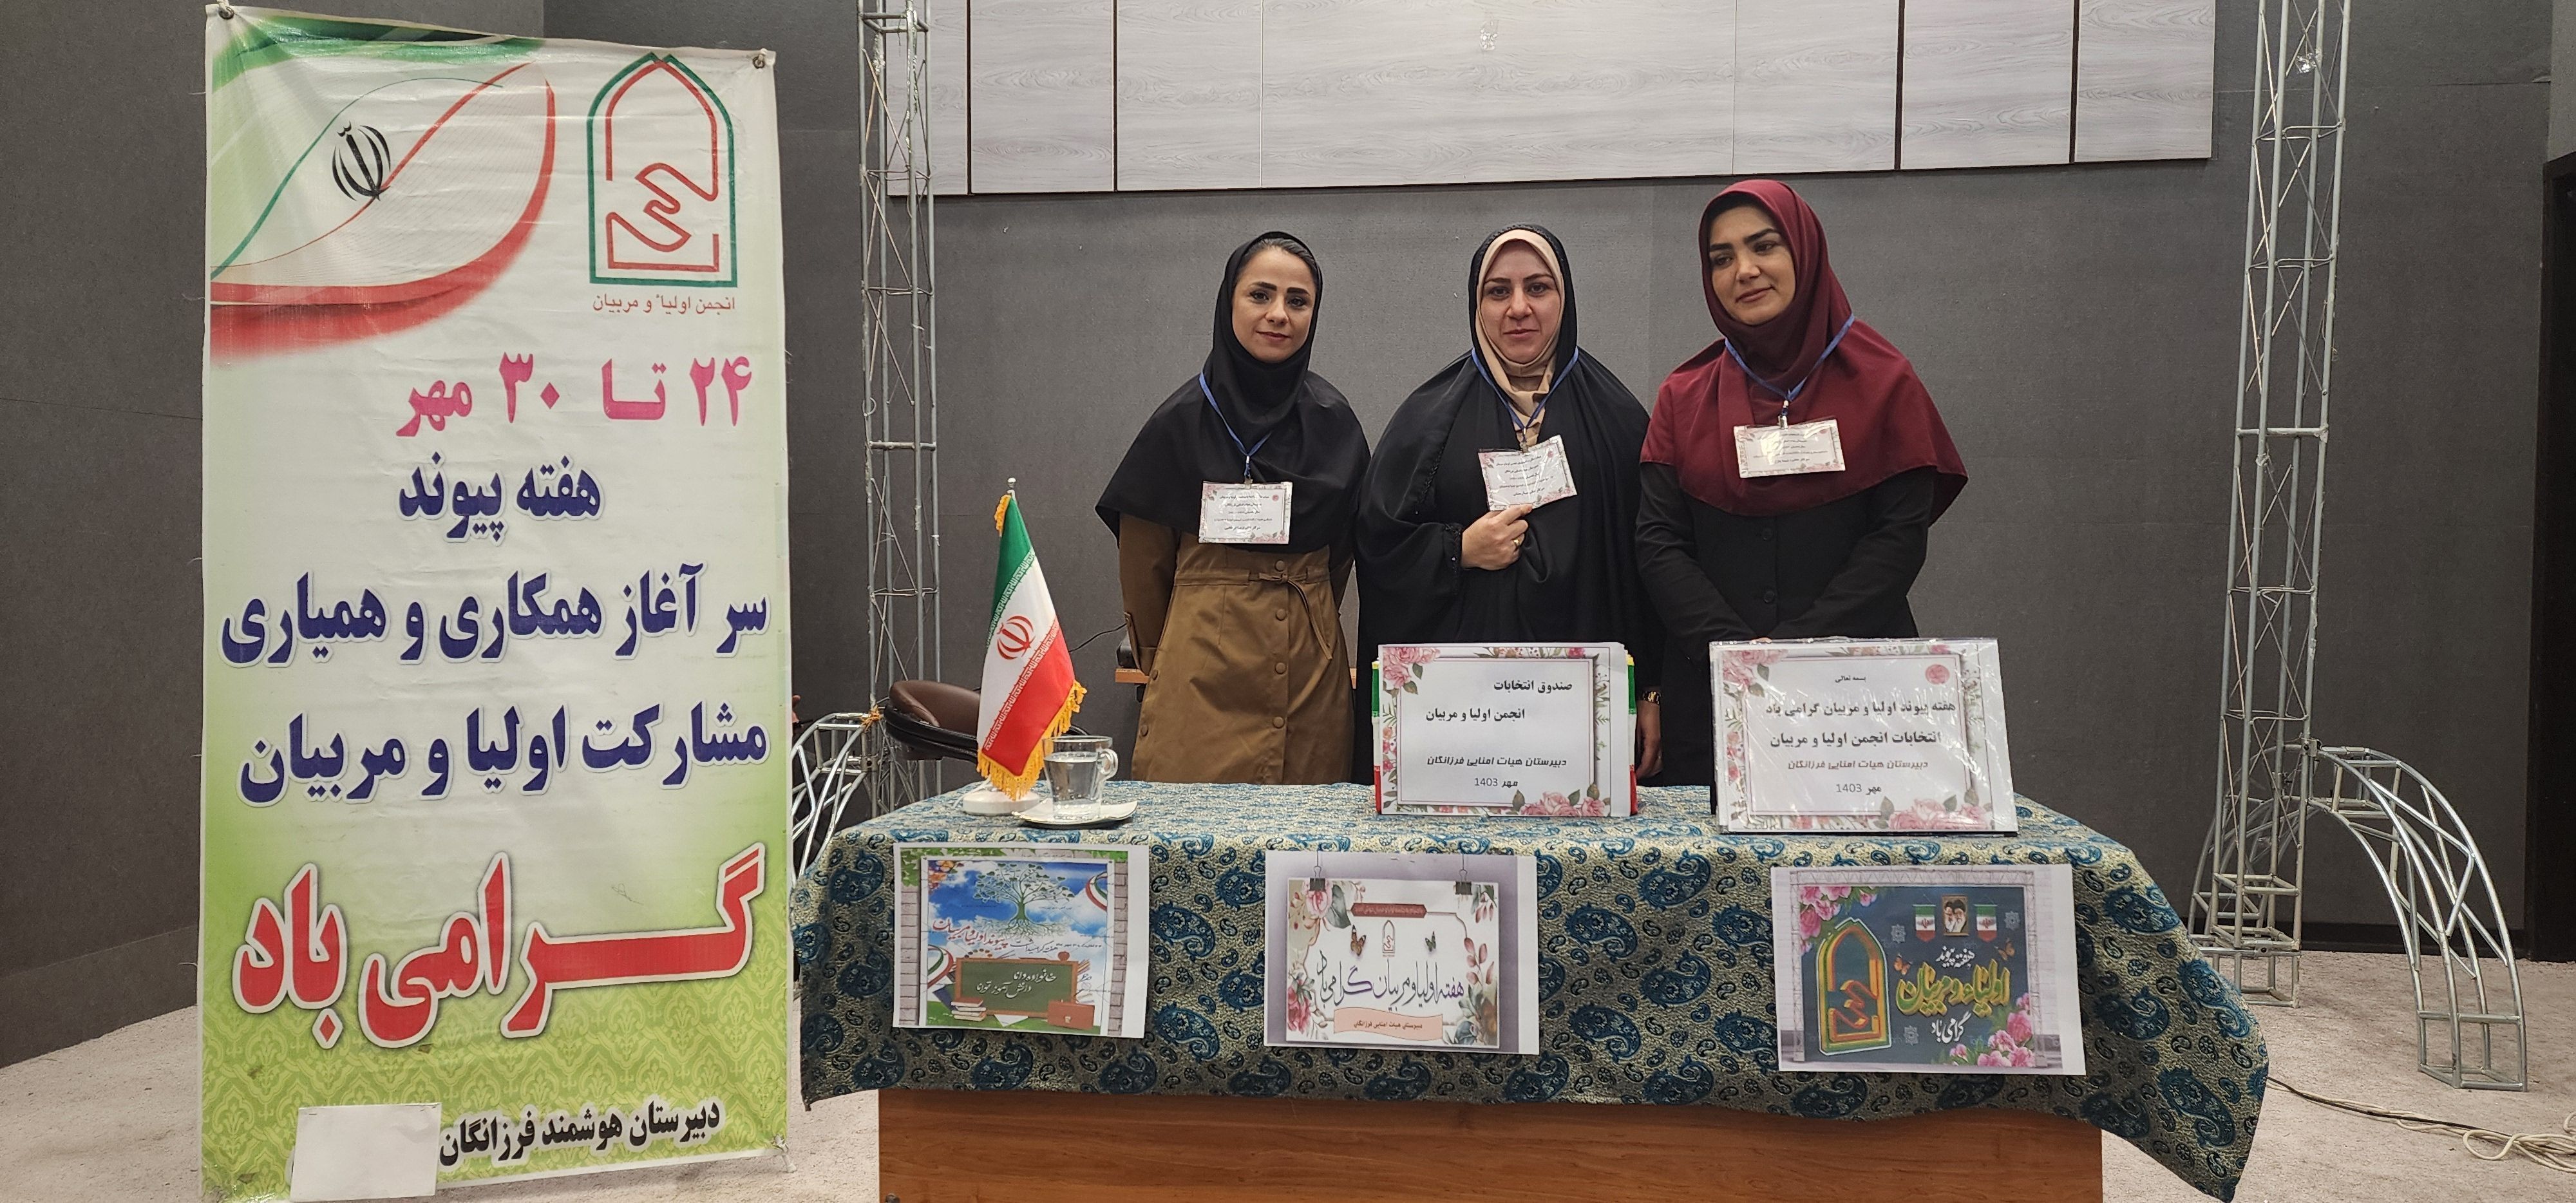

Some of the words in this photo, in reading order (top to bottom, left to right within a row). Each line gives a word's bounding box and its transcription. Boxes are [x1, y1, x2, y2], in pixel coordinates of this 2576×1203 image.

[592, 294, 639, 313] مربیان
[643, 298, 652, 313] و
[696, 296, 735, 315] انجمن
[498, 352, 560, 424] ۳۰
[601, 359, 667, 421] تا
[689, 355, 752, 426] ۲۴
[396, 381, 471, 437] مهر
[517, 455, 601, 516] هفته
[400, 451, 504, 541] پیوند
[223, 573, 386, 663] همیاری
[439, 572, 602, 659] همکاری
[615, 564, 704, 657] آغاز
[401, 600, 424, 661] و
[716, 596, 766, 656] سر
[1494, 679, 1533, 692] انتخابات
[1538, 683, 1573, 694] صندوق
[1426, 708, 1457, 722] مربیان
[1470, 708, 1490, 722] اولیا
[1494, 708, 1525, 722] انجمن
[1785, 703, 1819, 716] گرامی
[1824, 703, 1859, 716] مربیان
[1863, 705, 1869, 717] و
[1873, 702, 1895, 716] اولیا
[1932, 702, 1955, 711] هفته
[1461, 712, 1467, 722] و
[582, 701, 766, 786] مشارکت
[1771, 733, 1808, 747] مربیان
[1812, 737, 1819, 747] و
[1823, 732, 1847, 747] اولیا
[1852, 732, 1887, 746] انجمن
[1892, 732, 1941, 746] انتخابات
[466, 705, 565, 791] اولیا
[241, 714, 405, 802] مربیان
[1427, 756, 1464, 765] فرزانگان
[1467, 757, 1494, 766] امنایی
[1497, 757, 1522, 766] هیات
[1526, 758, 1566, 767] دبیرستان
[1788, 761, 1825, 769] فرزانگان
[422, 739, 448, 795] و
[1474, 778, 1498, 786] 1403
[1836, 784, 1862, 792] 1403
[1866, 785, 1881, 794] مهر
[365, 849, 759, 1041] گرامی
[240, 870, 339, 1041] باد
[1439, 978, 1464, 998] هفته
[1932, 1019, 1942, 1042] باد
[1942, 1011, 1971, 1043] گرامی
[542, 1113, 621, 1150] هوشمند
[630, 1099, 720, 1148] دبیرستان
[440, 1112, 536, 1166] فرزانگان
